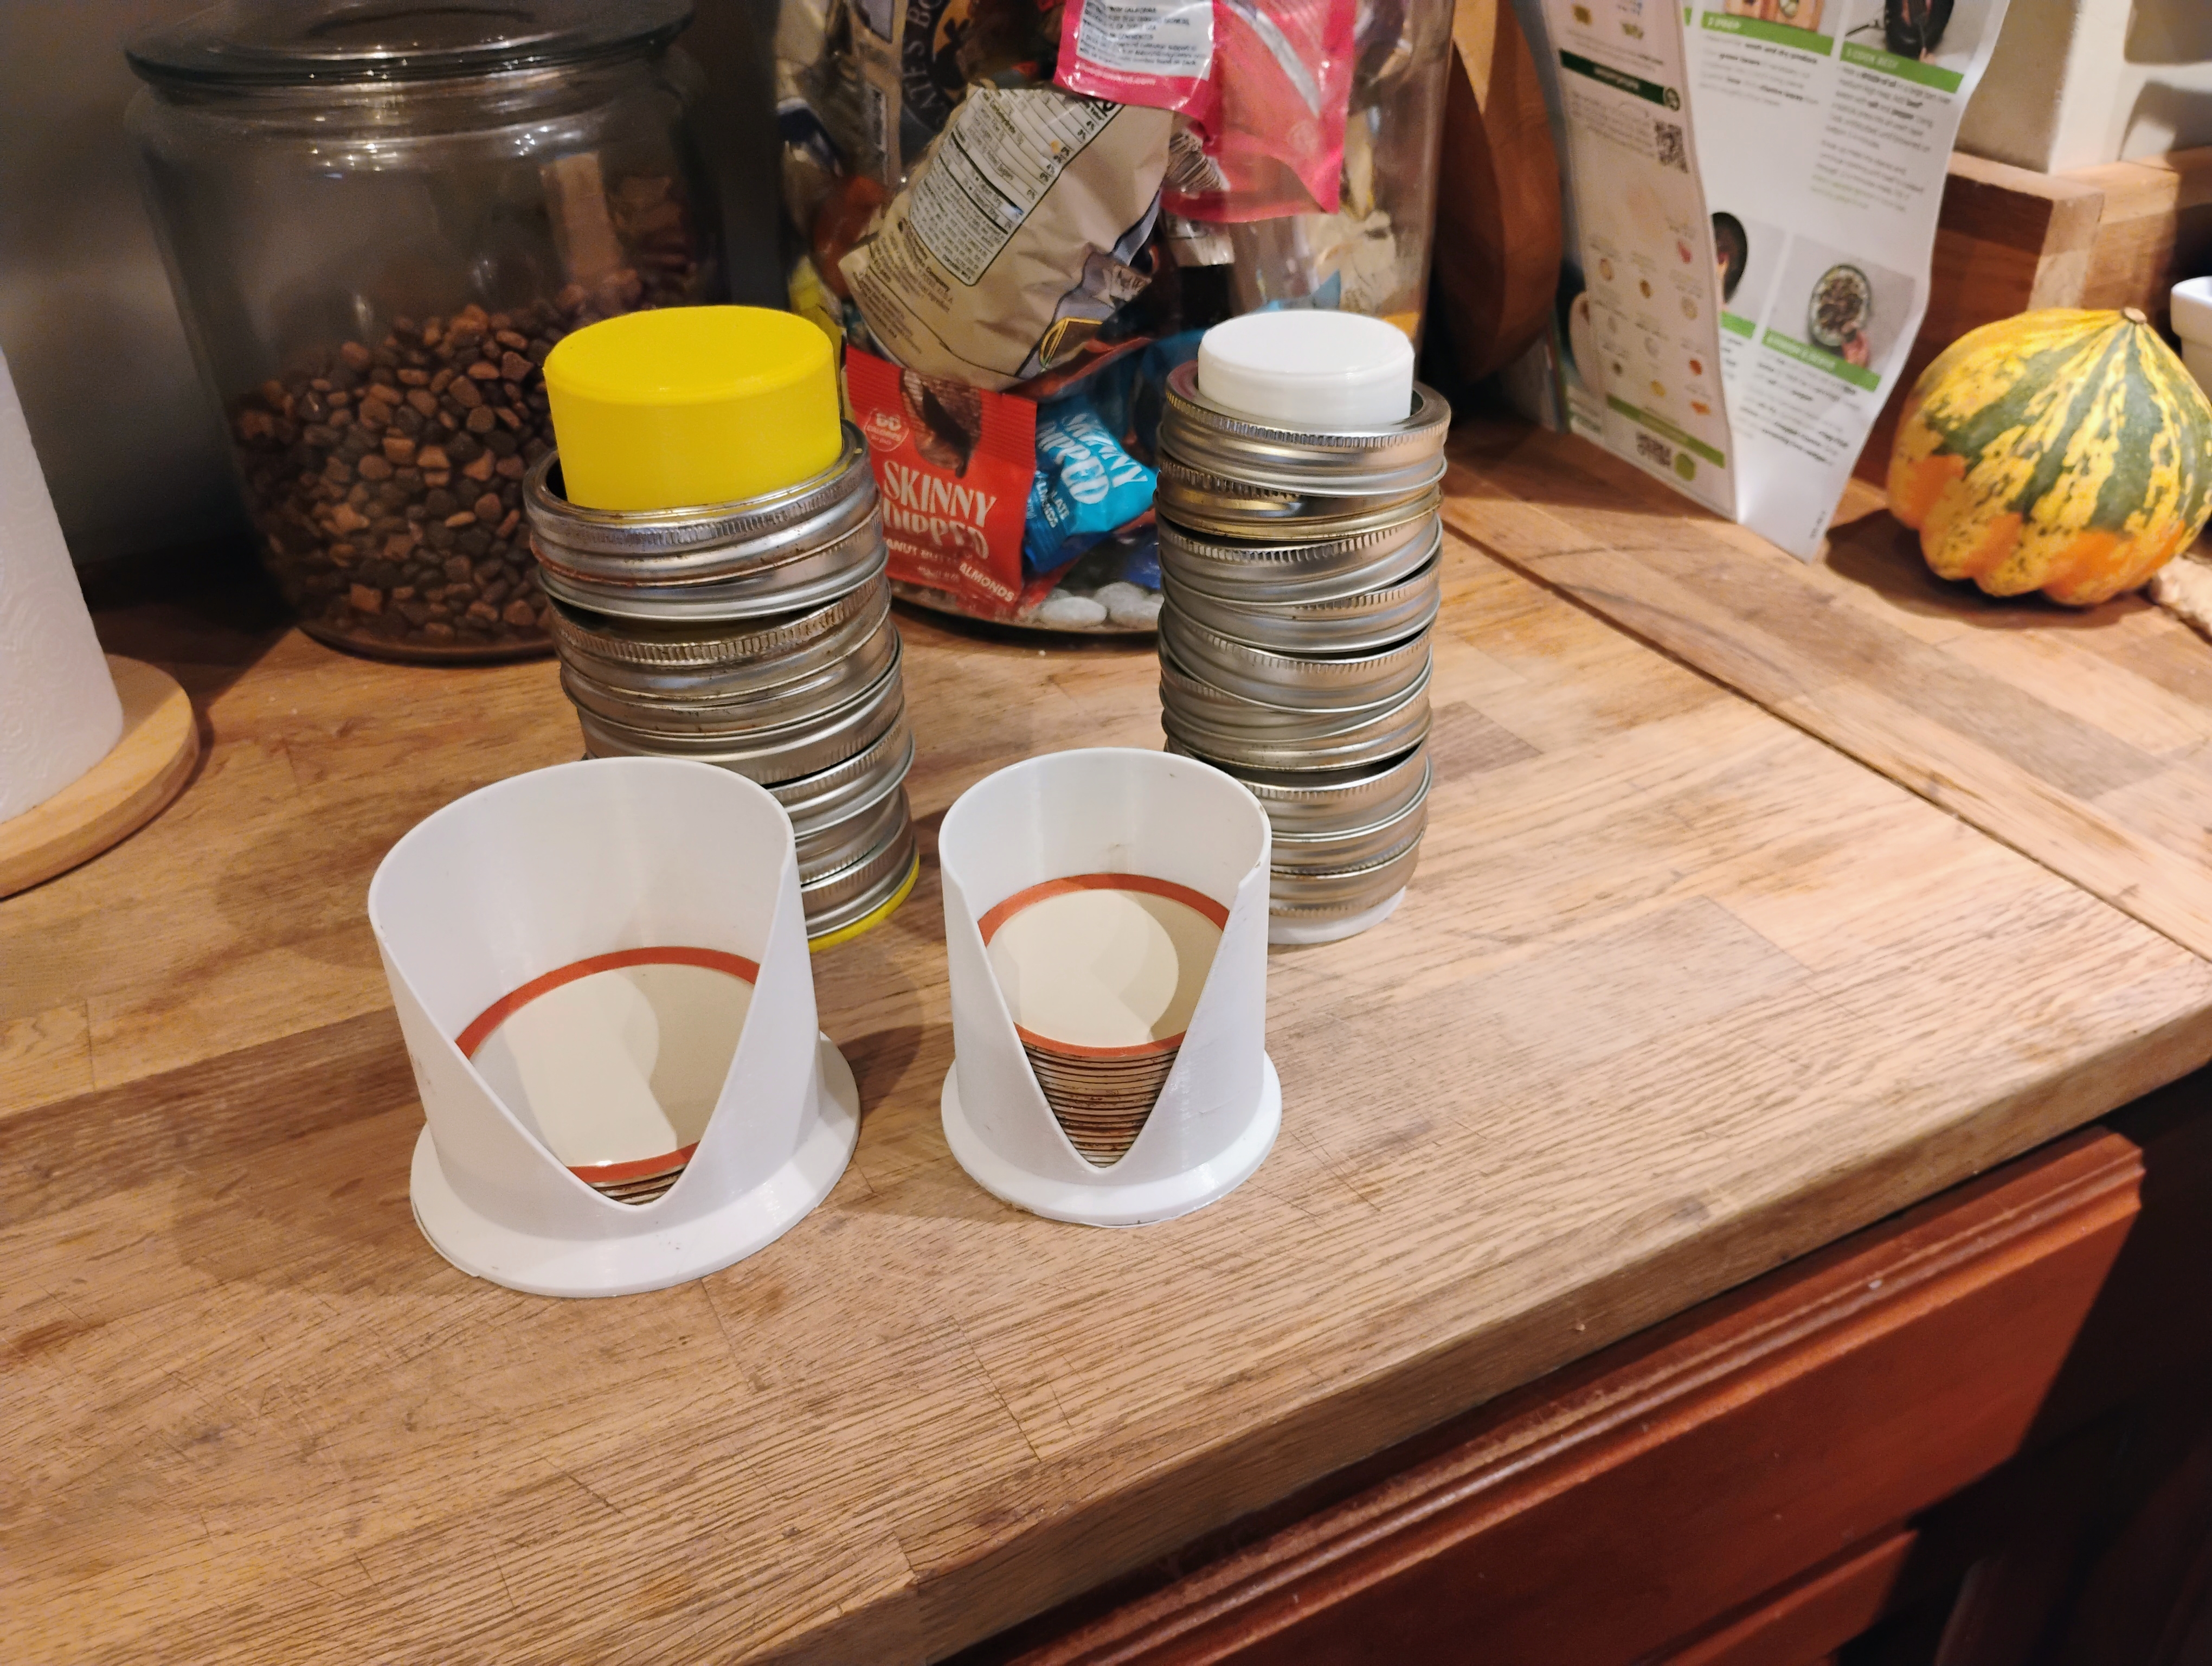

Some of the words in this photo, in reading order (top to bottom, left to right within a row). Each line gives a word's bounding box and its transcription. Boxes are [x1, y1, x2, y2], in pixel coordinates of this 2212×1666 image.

[1061, 413, 1148, 488] SKINNY
[884, 460, 997, 528] SKINNY
[959, 562, 1014, 602] ALMONDS
